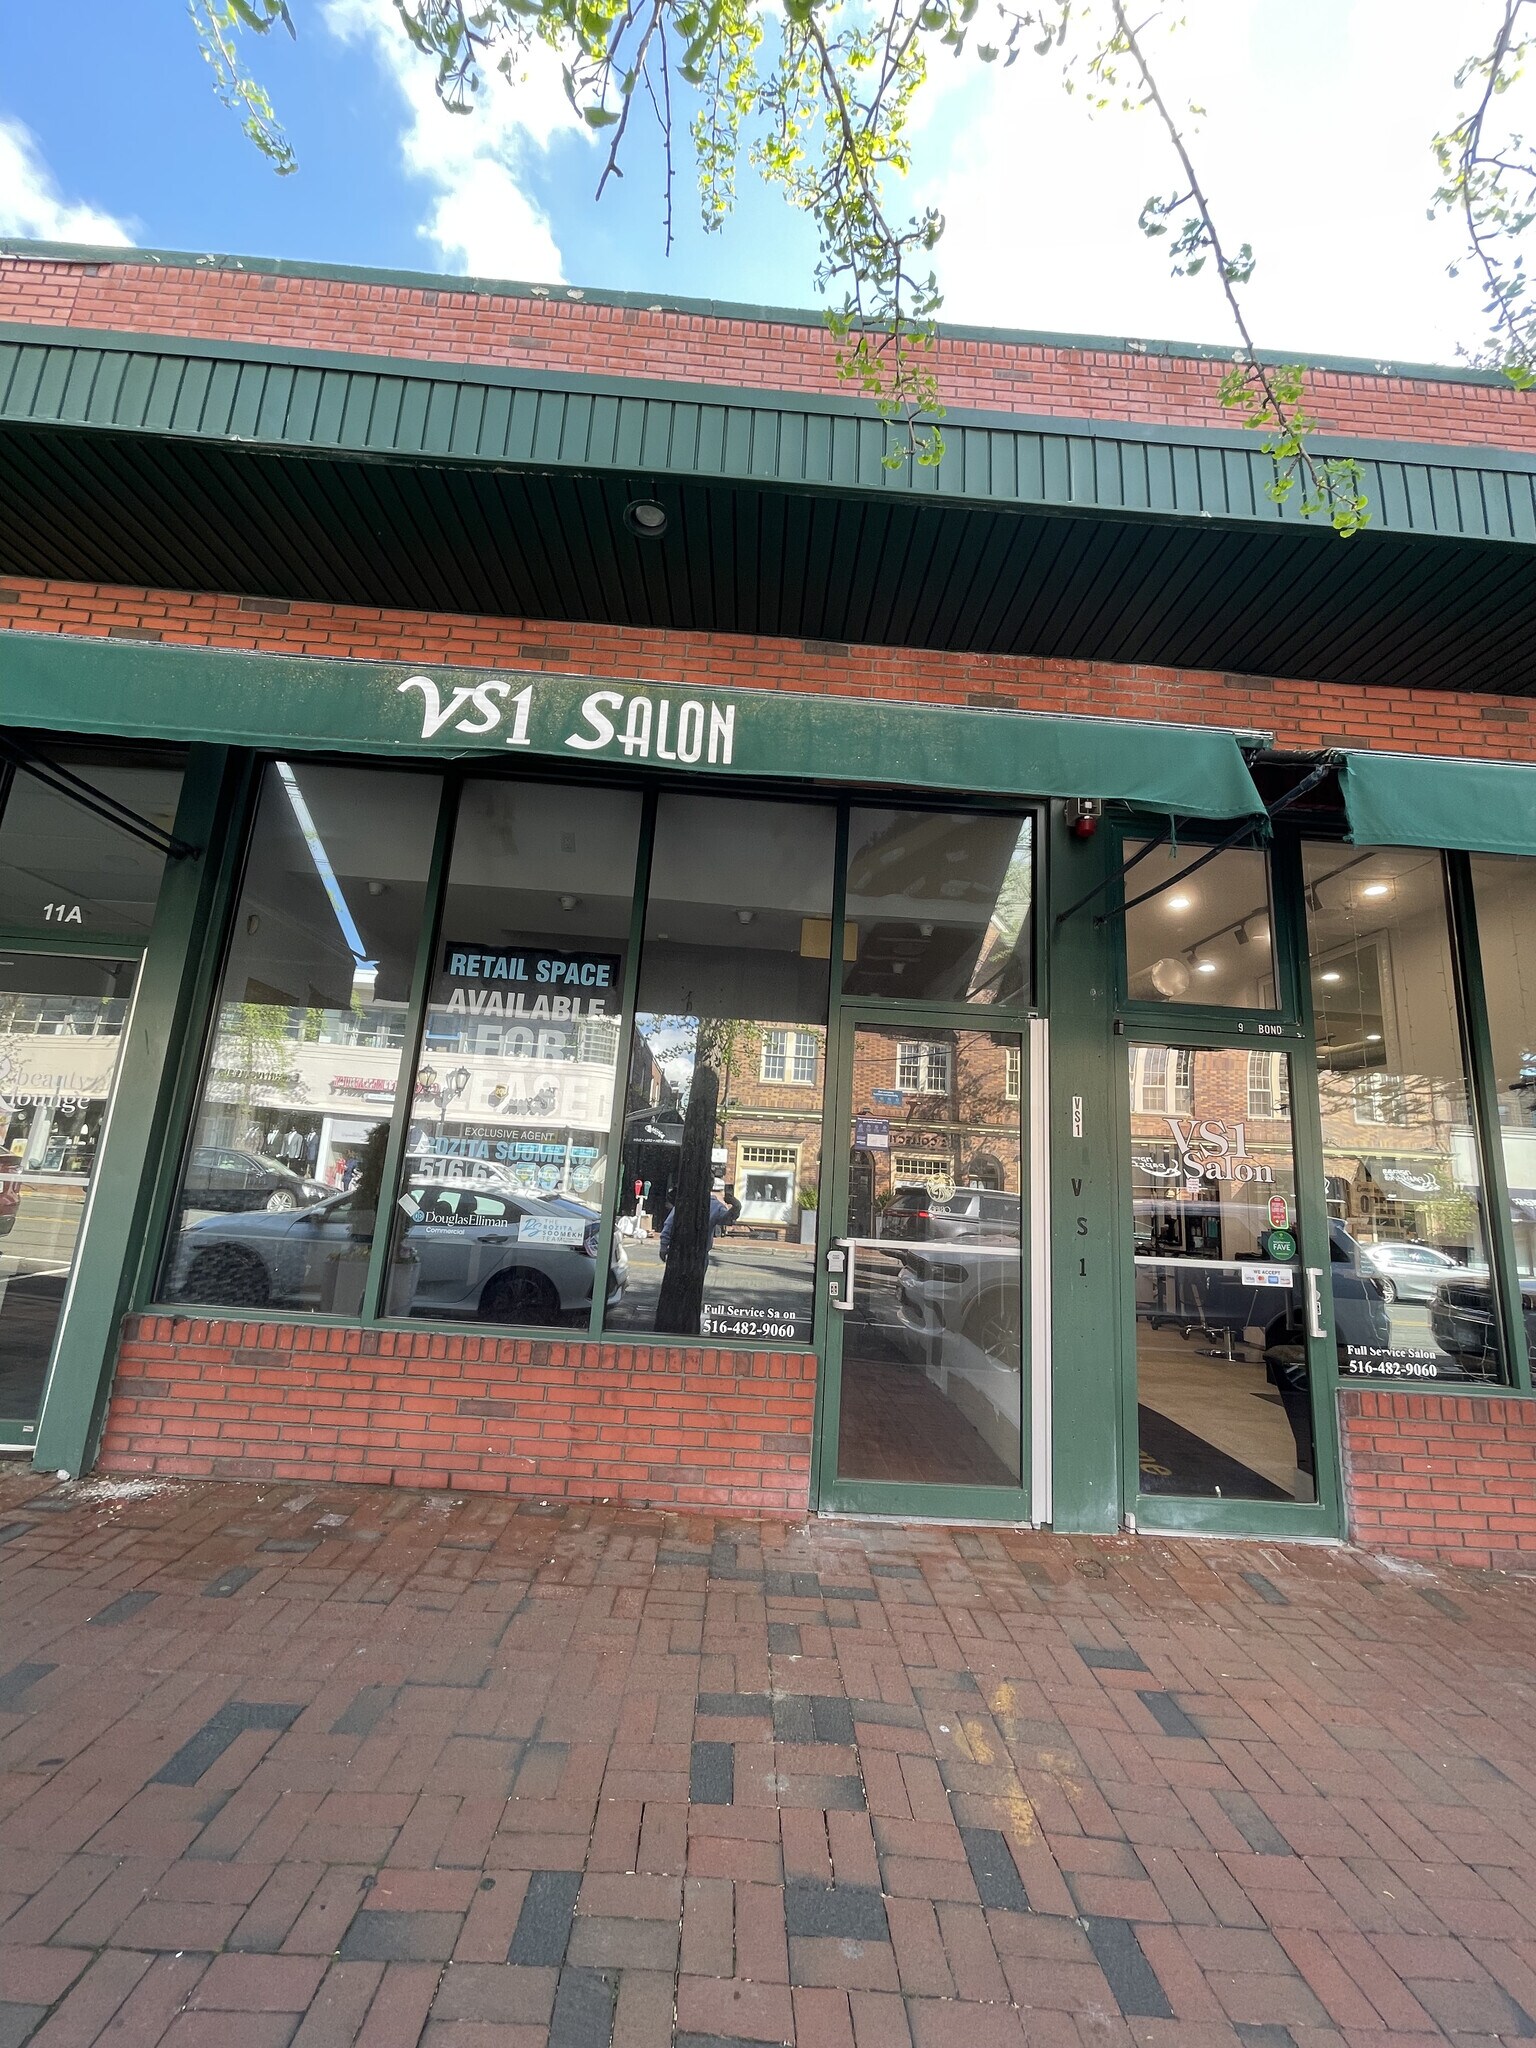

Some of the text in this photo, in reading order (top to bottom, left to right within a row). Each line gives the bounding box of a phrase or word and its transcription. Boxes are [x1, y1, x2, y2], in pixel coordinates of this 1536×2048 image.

[397, 675, 735, 764] VS1 SALON
[43, 903, 82, 923] 11A
[450, 953, 610, 987] RETAIL SPACE
[445, 988, 605, 1024] AVAILABLE
[1237, 1022, 1282, 1035] 9 BOND
[473, 1024, 567, 1068] FOR
[9, 1086, 91, 1113] lounge
[464, 1127, 555, 1141] EXCLUSIVE AGENT
[1162, 1117, 1254, 1159] VS1
[1183, 1151, 1276, 1183] Salon
[426, 1226, 465, 1235] Commercial
[542, 1230, 583, 1238] SOOMEKH
[1273, 1243, 1291, 1251] FAVE
[704, 1304, 724, 1315] Full
[727, 1305, 765, 1318] Service
[703, 1319, 795, 1338] 516-482-9060
[1347, 1344, 1436, 1360] Full Service Salon
[1349, 1360, 1437, 1377] 516-482-9060
